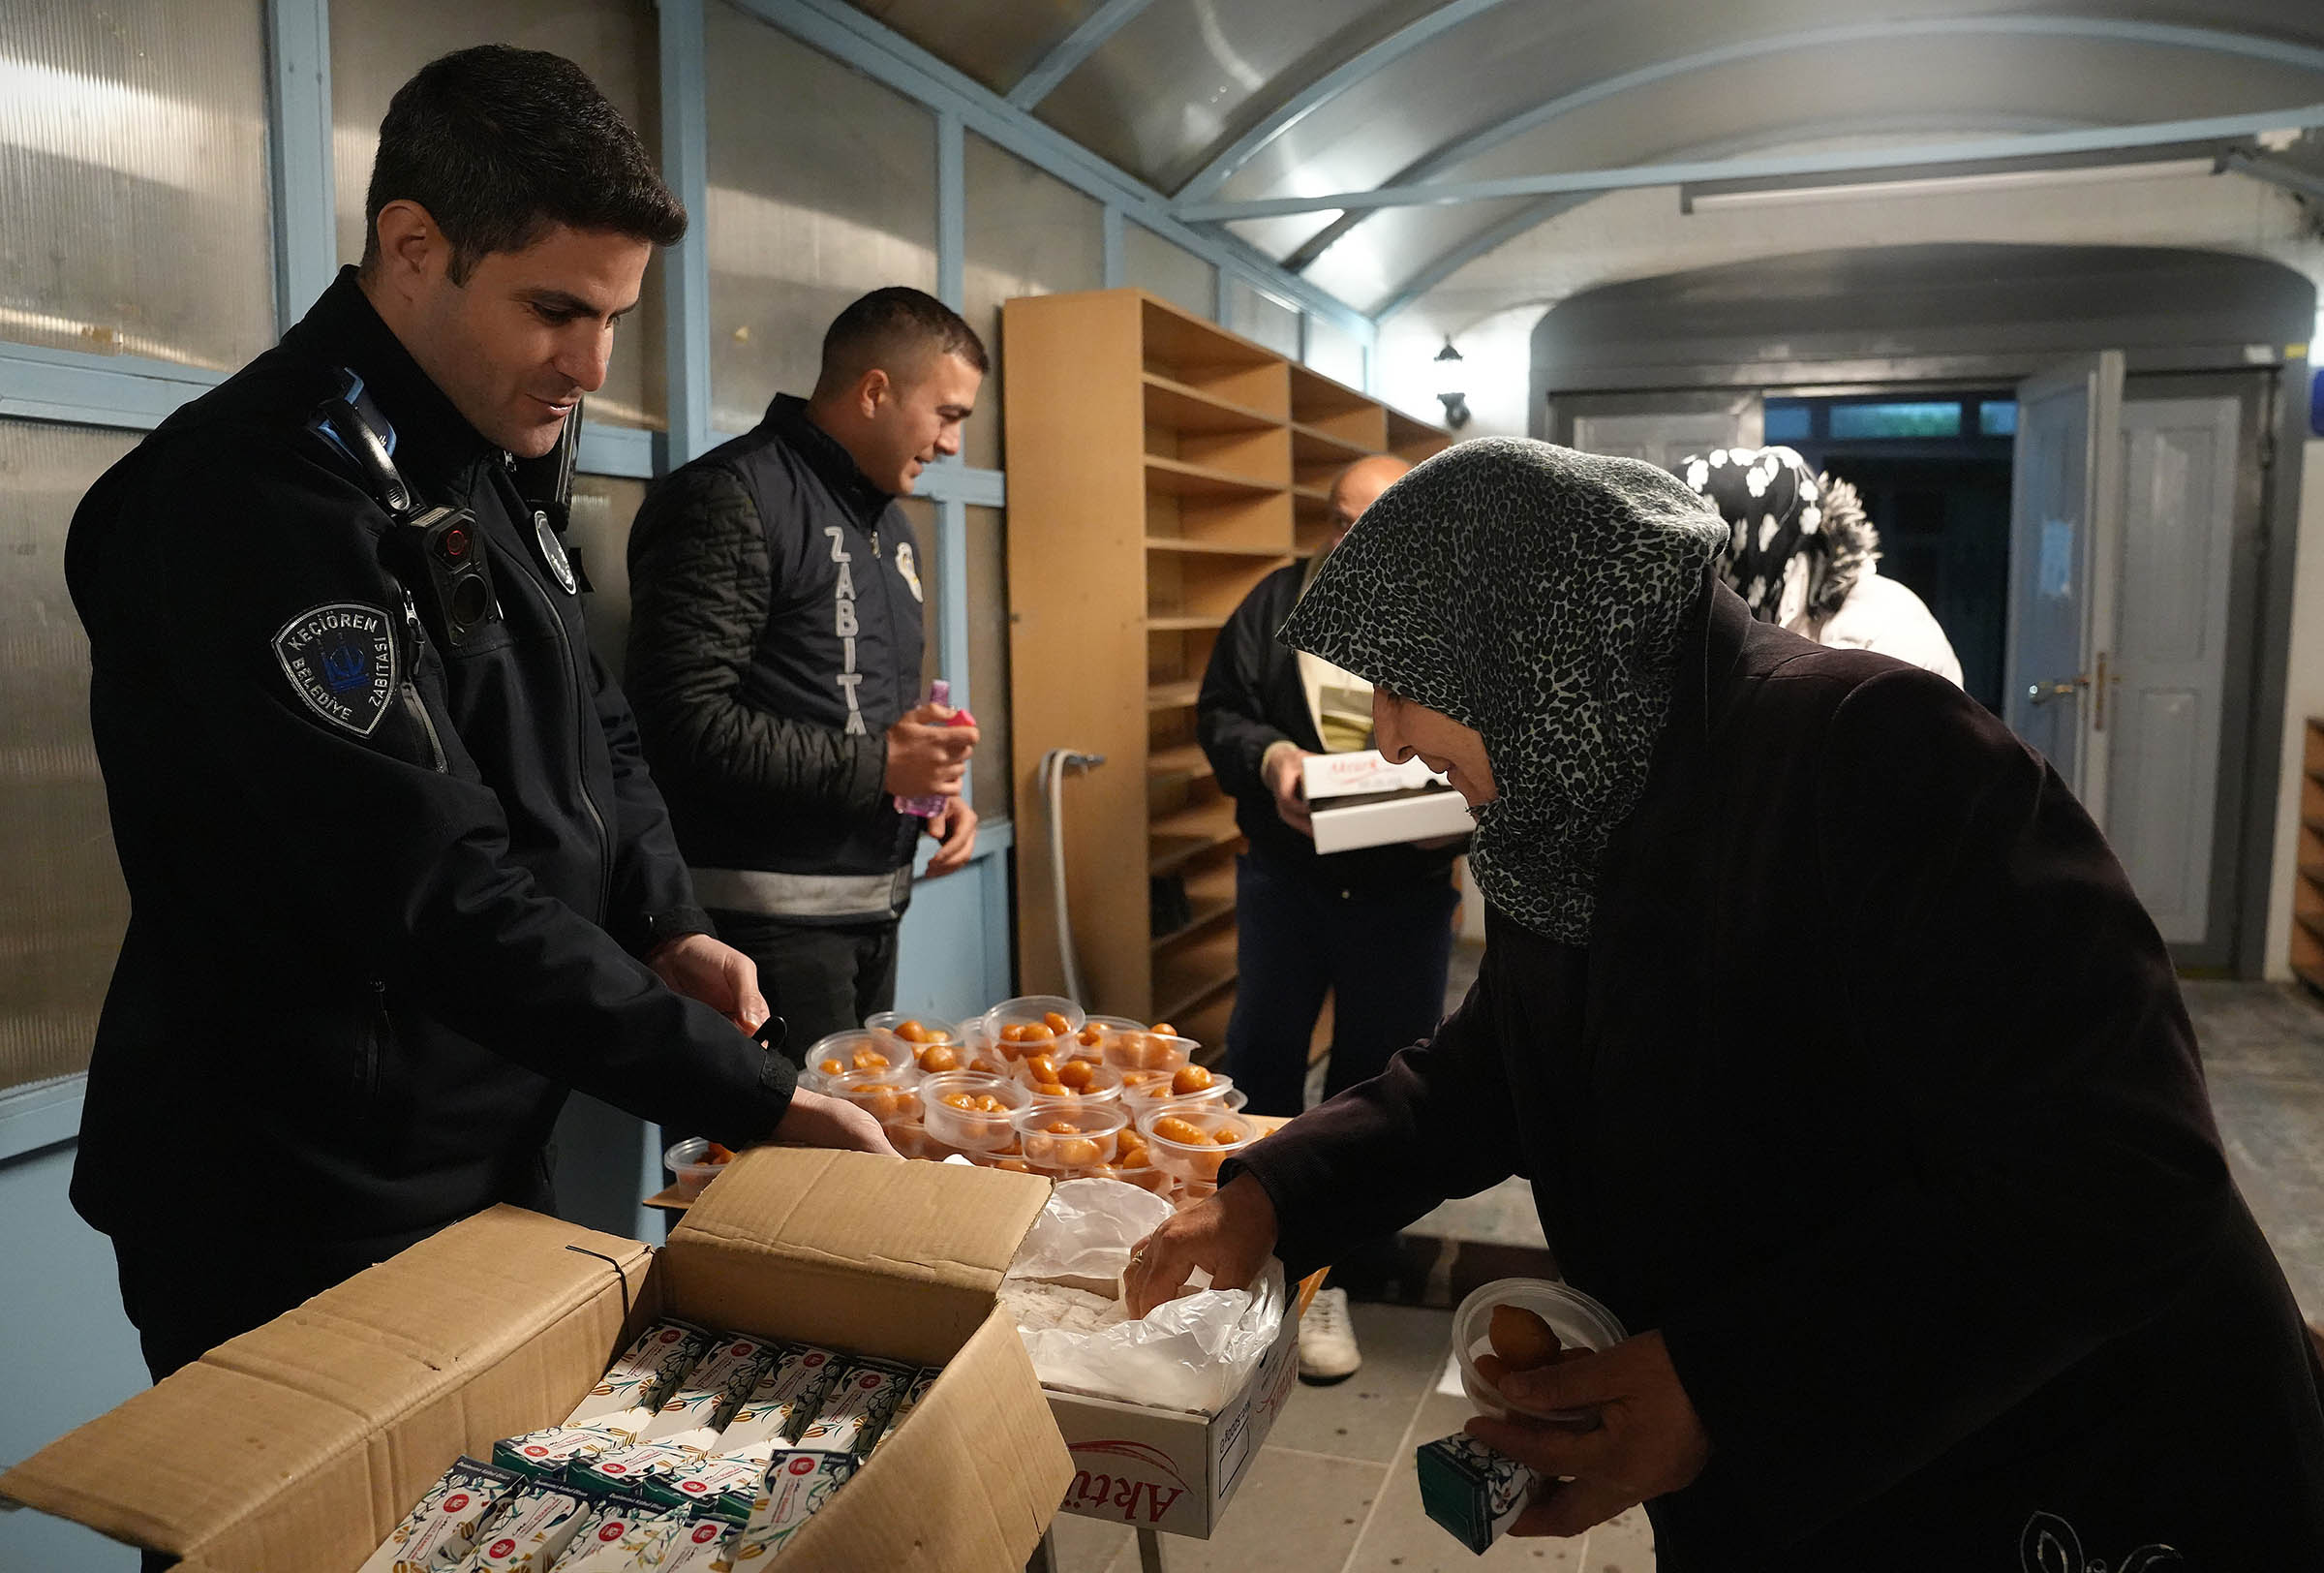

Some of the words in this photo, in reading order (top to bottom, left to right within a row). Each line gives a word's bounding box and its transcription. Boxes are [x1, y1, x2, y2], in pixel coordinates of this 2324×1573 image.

[824, 526, 867, 735] ZABITA
[291, 657, 353, 722] BELEDİYE
[368, 636, 390, 708] ZABITASI
